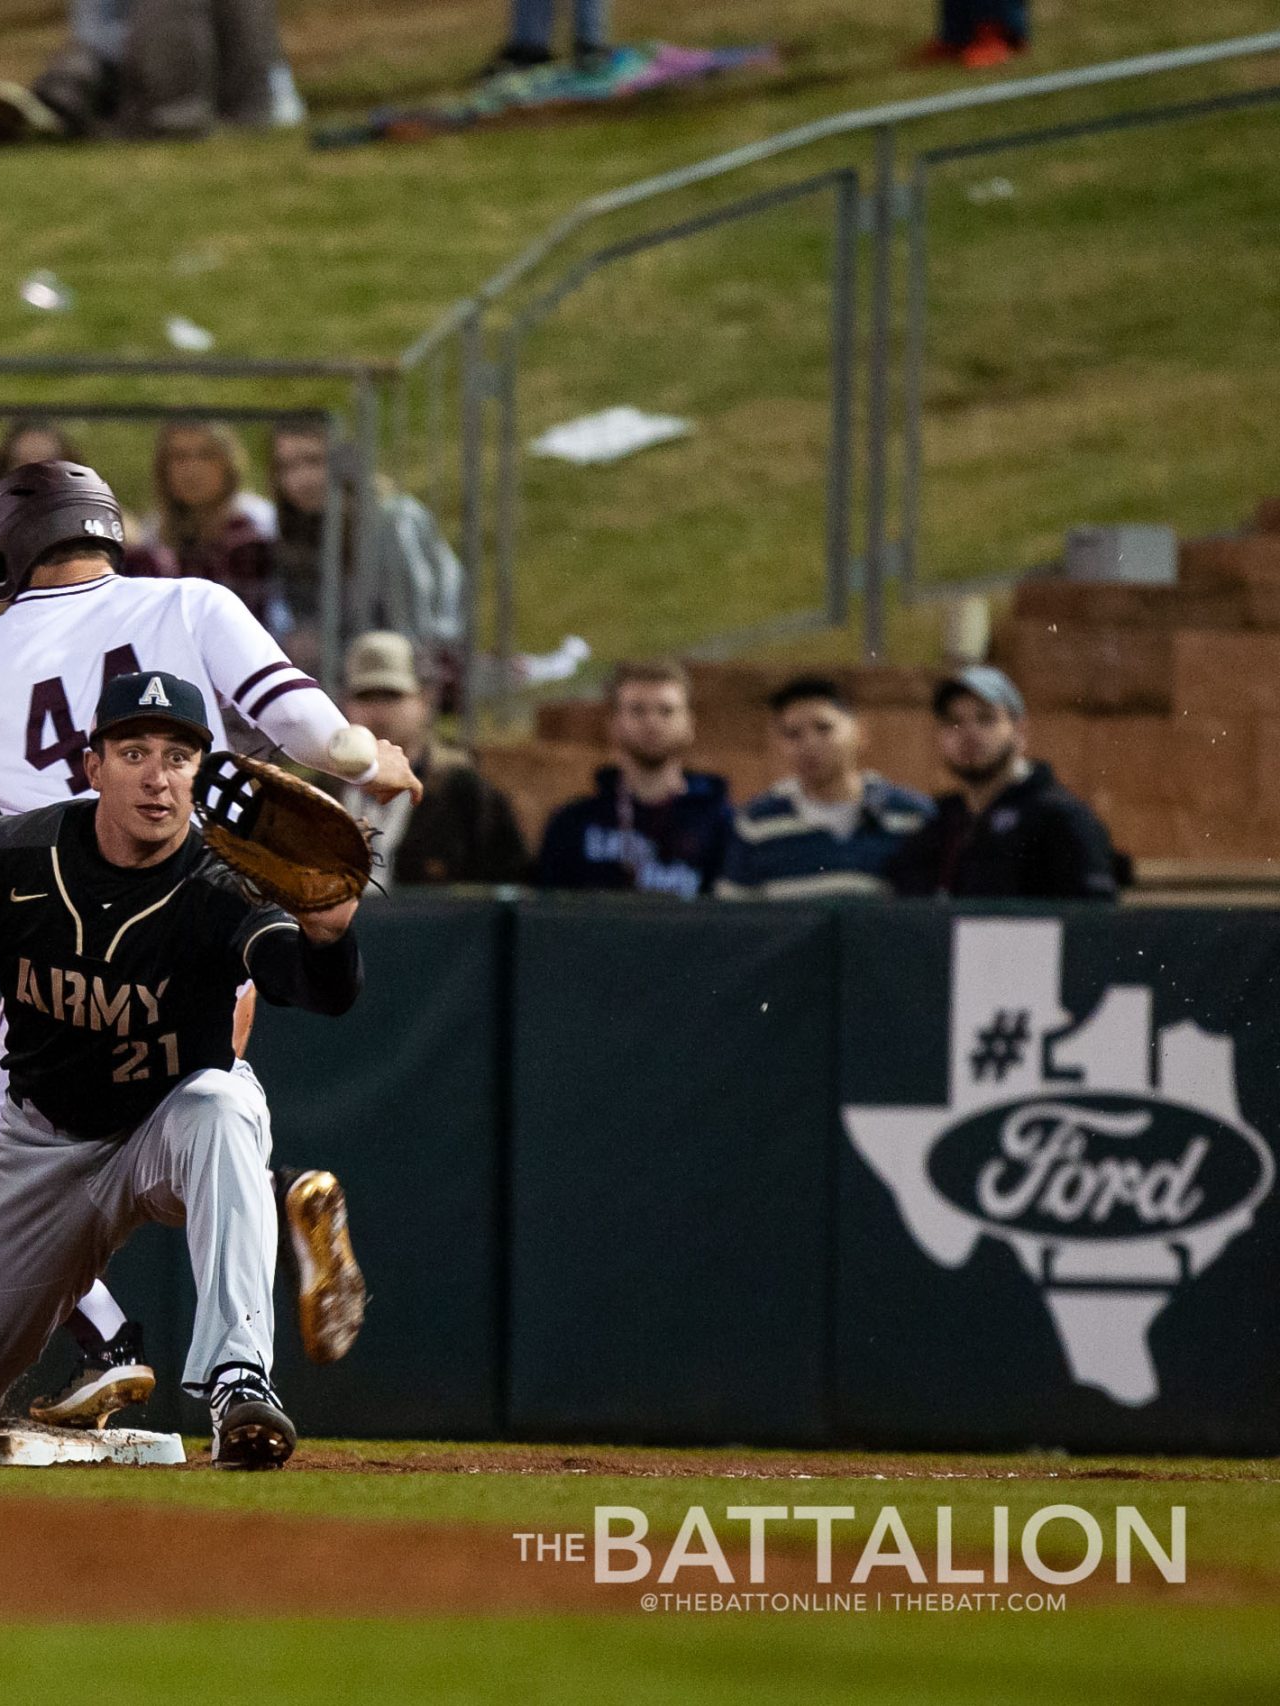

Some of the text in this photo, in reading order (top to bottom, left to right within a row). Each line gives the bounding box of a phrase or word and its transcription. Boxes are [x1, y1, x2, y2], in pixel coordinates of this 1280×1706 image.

[25, 643, 142, 796] 4
[138, 676, 170, 706] A
[16, 957, 170, 1037] ARMY
[112, 1032, 180, 1083] 21
[977, 1103, 1211, 1224] Ford
